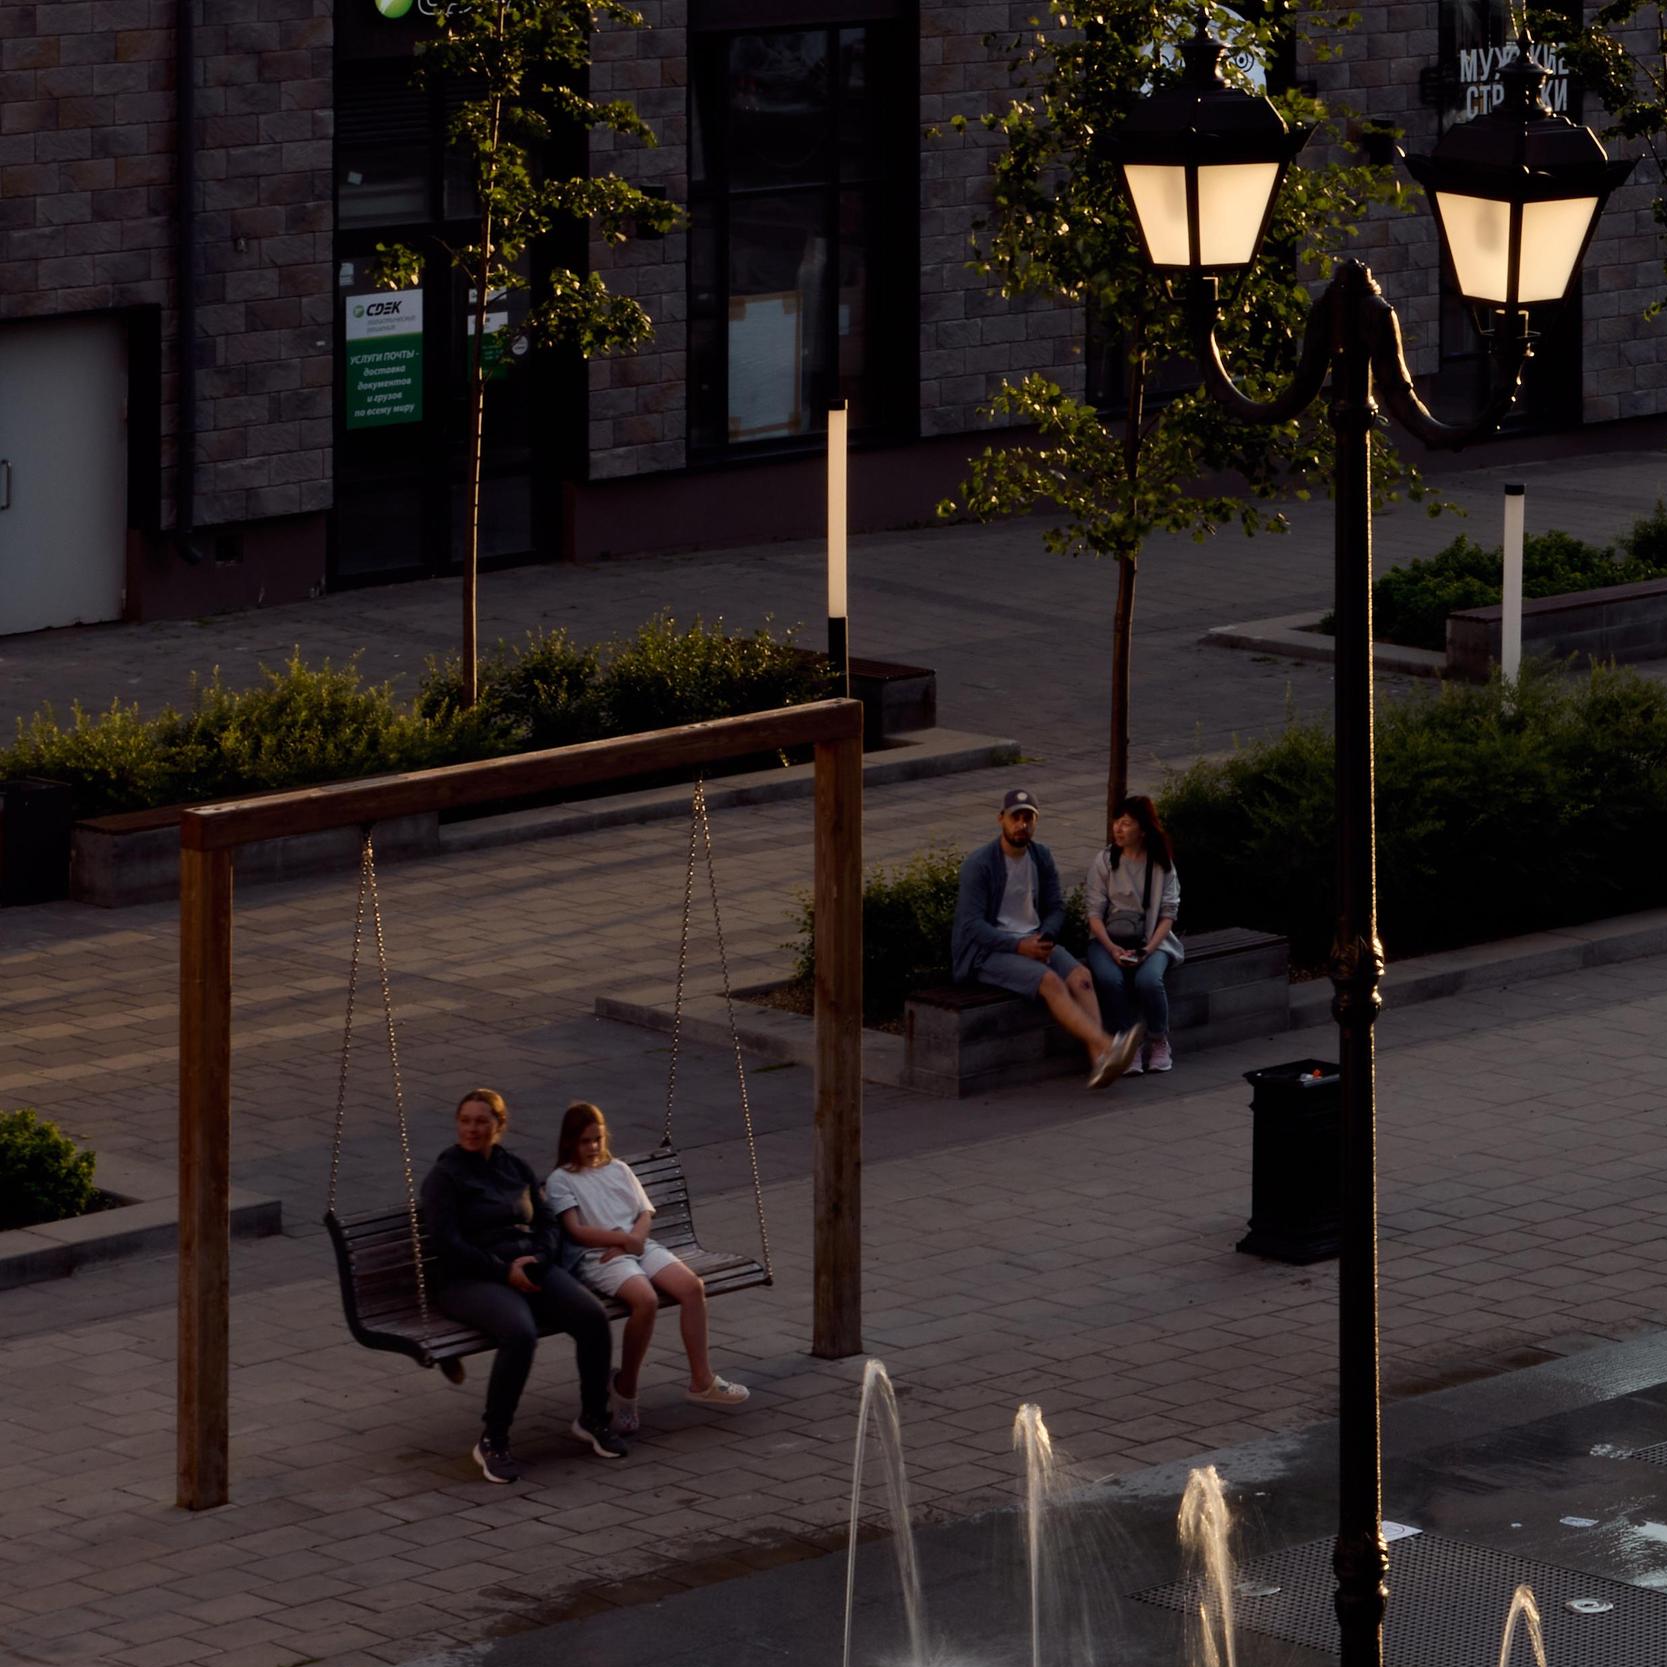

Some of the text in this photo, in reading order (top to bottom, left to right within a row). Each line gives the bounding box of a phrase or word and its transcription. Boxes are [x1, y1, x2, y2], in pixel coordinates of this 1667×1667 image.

[1466, 78, 1568, 121] СТРКИ
[367, 301, 402, 317] CDEK
[350, 353, 383, 365] УСЛУГИ
[383, 350, 414, 361] ПОЧТЫ
[363, 365, 406, 377] доставка
[357, 378, 411, 391] документов
[367, 392, 403, 404] и грузов
[354, 403, 415, 417] по всему миру
